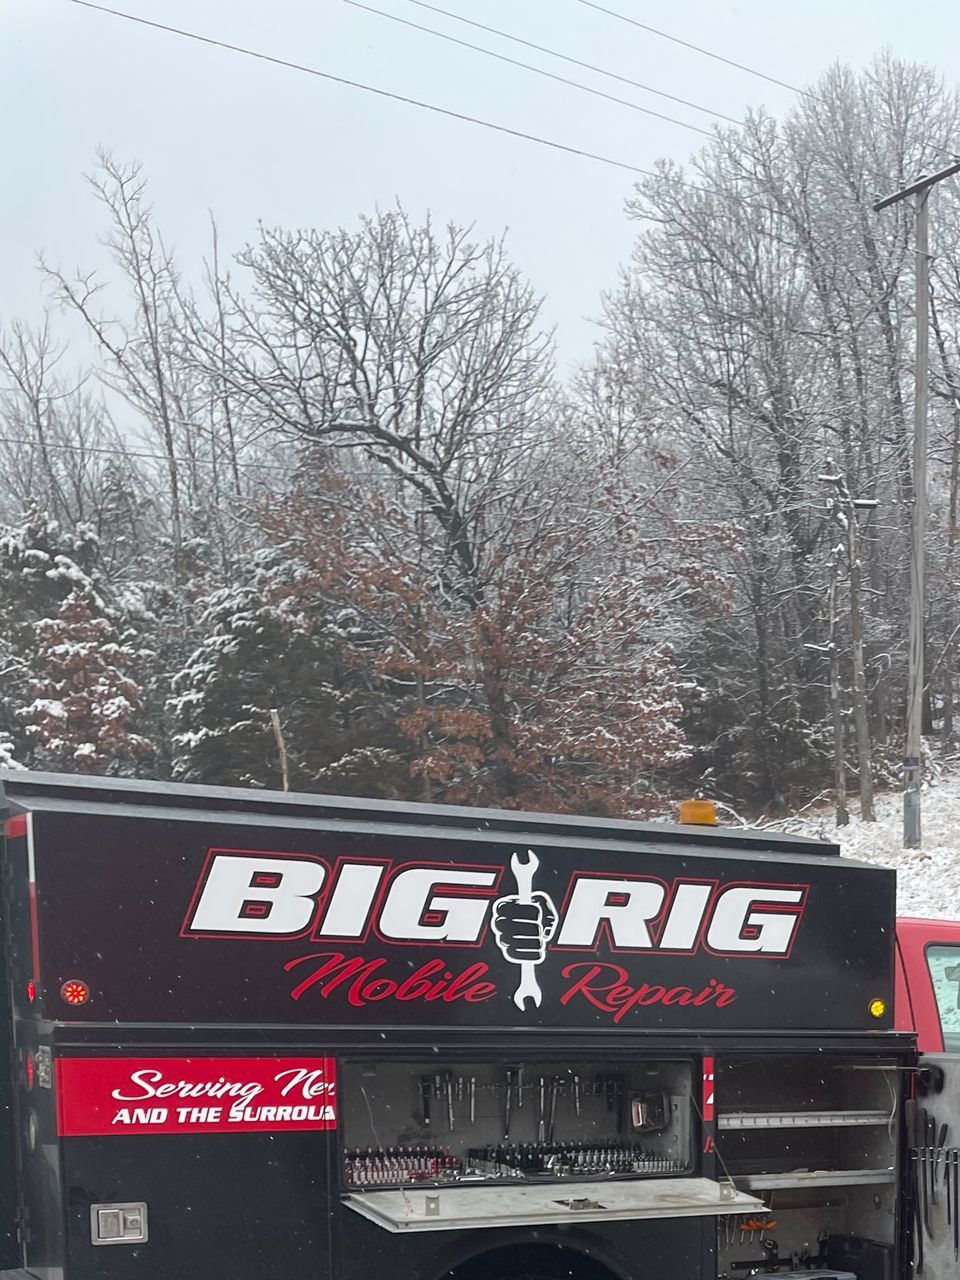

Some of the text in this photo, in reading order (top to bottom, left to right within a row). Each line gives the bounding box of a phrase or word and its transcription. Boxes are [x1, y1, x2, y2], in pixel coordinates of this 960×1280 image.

[182, 850, 808, 958] BIG RIG
[284, 952, 736, 1023] Mobile Repair
[111, 1069, 264, 1109] Serving
[112, 1108, 168, 1125] AND
[177, 1107, 222, 1123] THE
